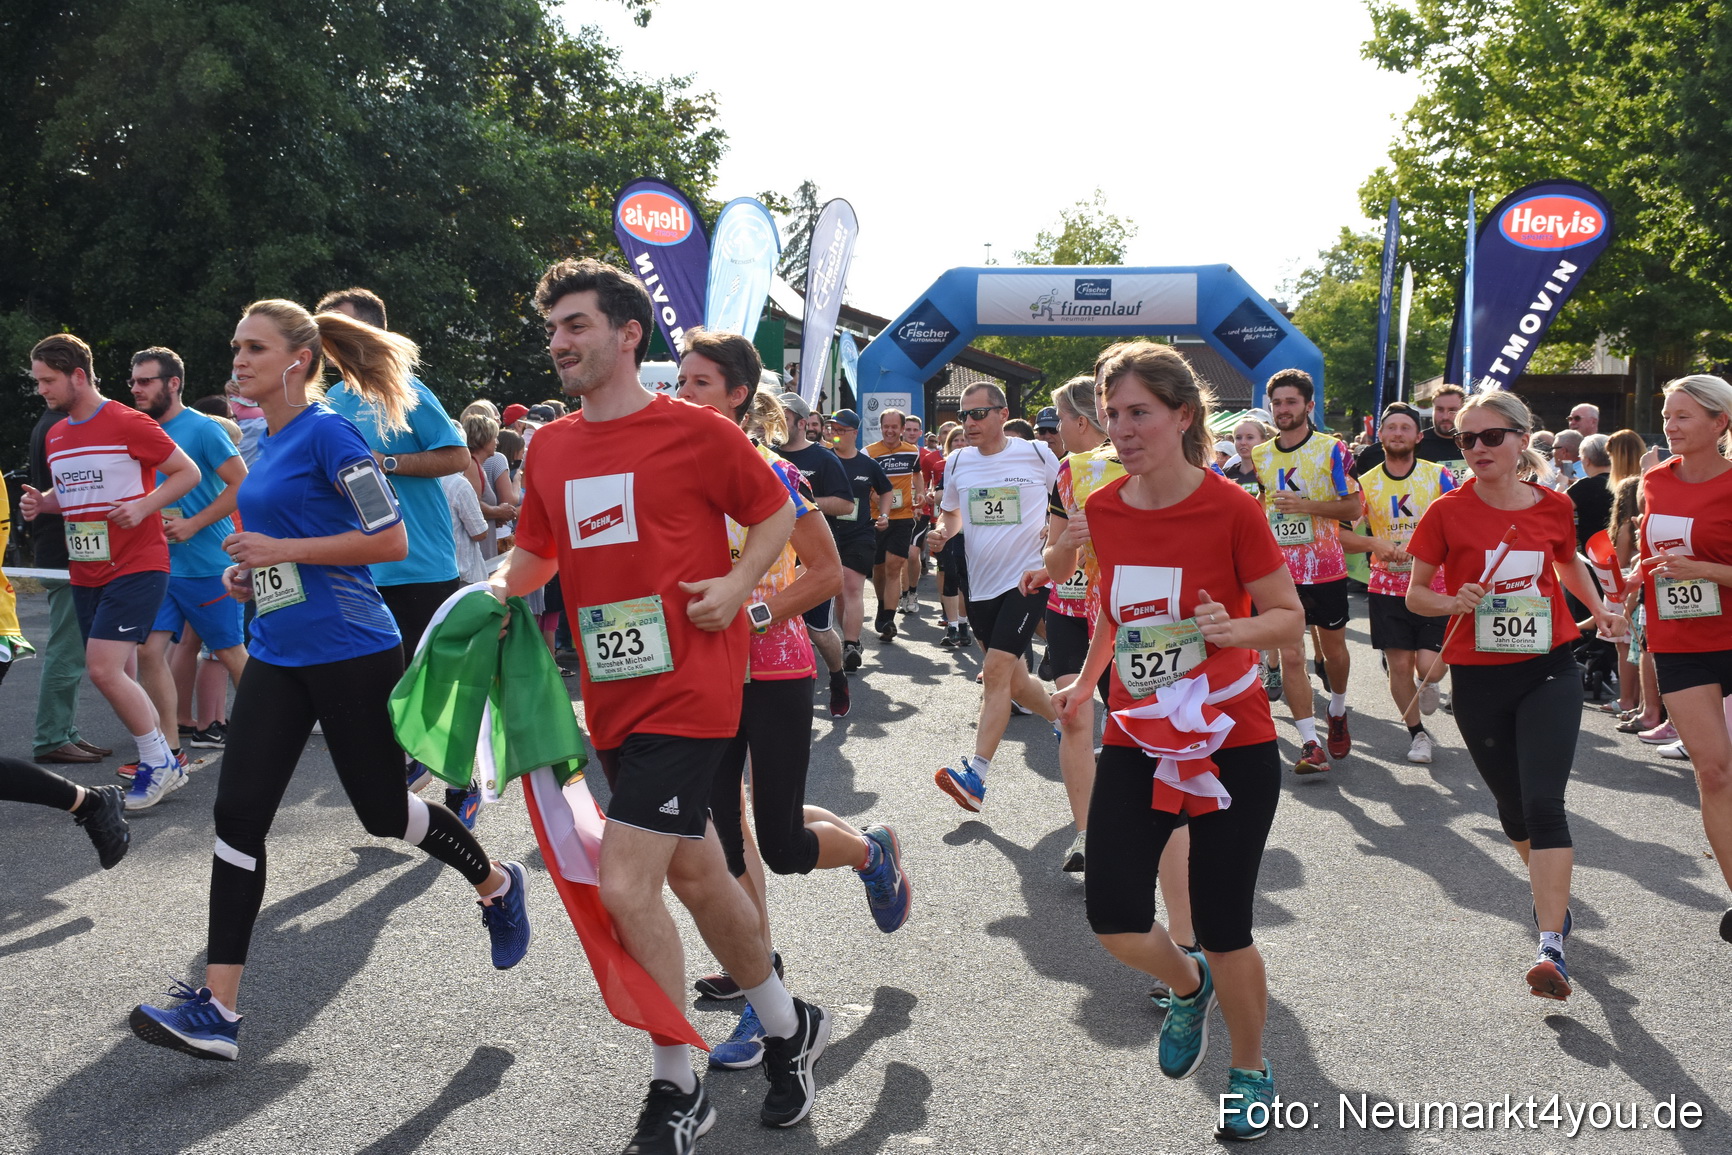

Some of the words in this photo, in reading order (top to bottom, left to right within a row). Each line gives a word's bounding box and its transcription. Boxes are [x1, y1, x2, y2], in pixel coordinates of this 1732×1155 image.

[1510, 208, 1596, 239] Hervis
[1082, 286, 1109, 294] Fischer
[1061, 301, 1143, 316] firmenlauf
[906, 327, 950, 338] Fischer
[62, 469, 103, 483] Petry
[984, 500, 1004, 515] 34
[590, 514, 612, 531] DEHN
[1275, 522, 1306, 536] 1320
[69, 535, 100, 550] 1811
[254, 566, 283, 598] 576
[1505, 580, 1525, 590] DEHN
[1667, 584, 1703, 605] 530
[1133, 604, 1156, 616] DEHN
[1492, 616, 1538, 638] 504
[596, 628, 645, 660] 523
[1180, 636, 1198, 646] 2019
[597, 659, 624, 669] Moroshek
[625, 653, 655, 665] Michael
[1130, 647, 1182, 680] 527
[1127, 675, 1172, 687] Ochsenkühn
[659, 806, 680, 816] adidas
